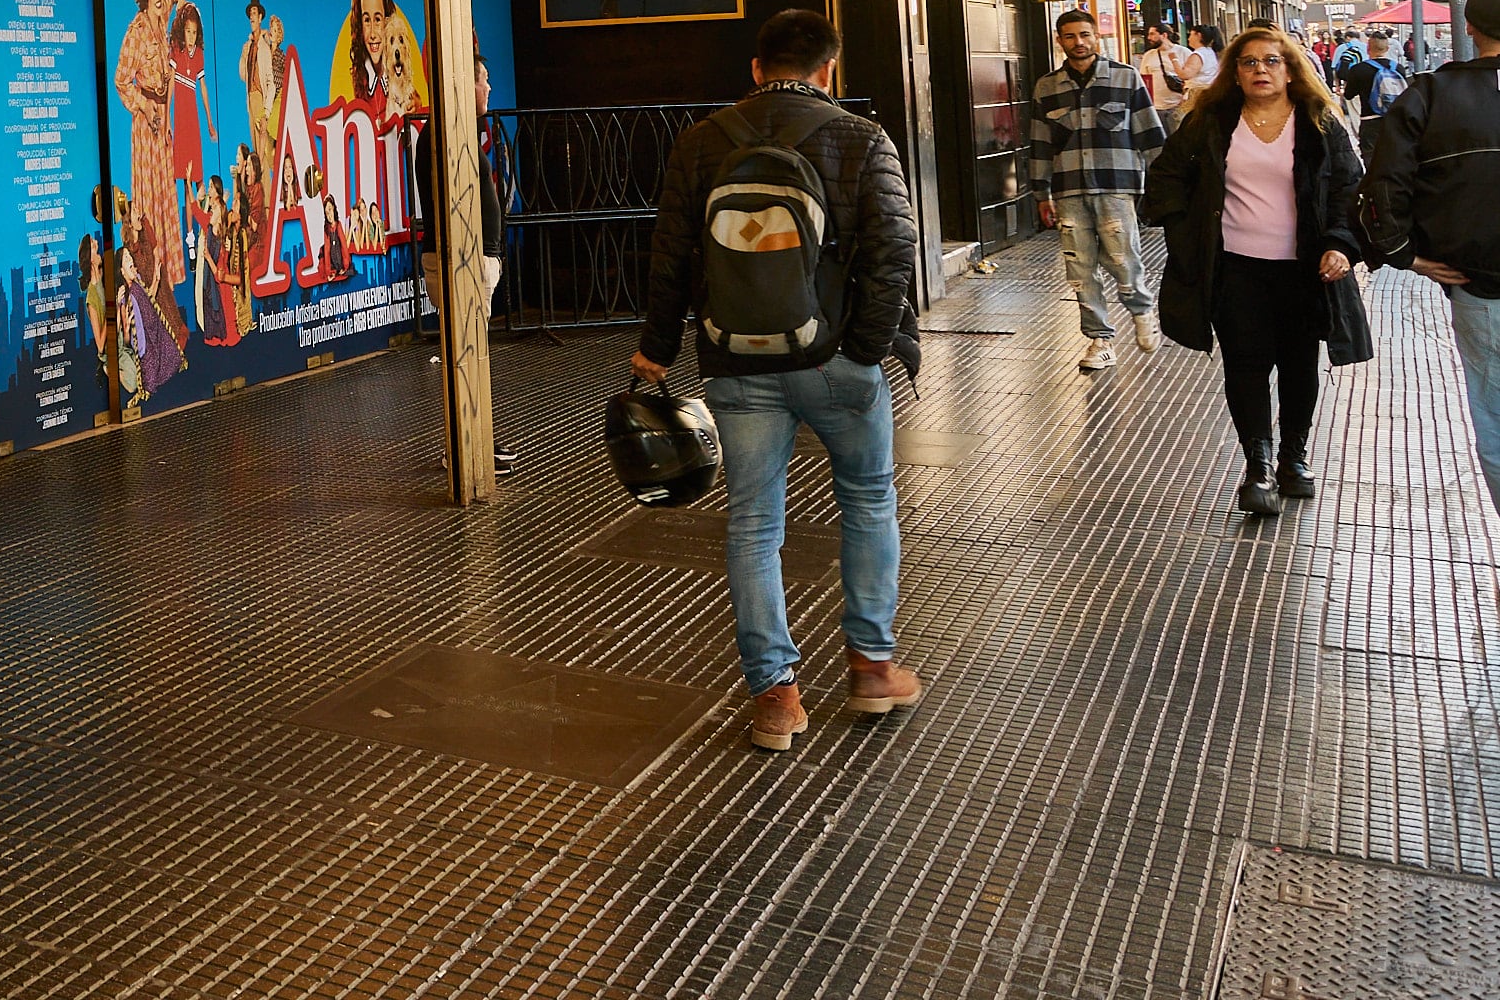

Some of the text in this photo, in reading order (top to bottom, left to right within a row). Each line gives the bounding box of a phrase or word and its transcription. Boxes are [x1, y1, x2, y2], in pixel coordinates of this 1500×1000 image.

[259, 308, 295, 333] Producción
[295, 301, 320, 324] Artística
[320, 294, 349, 319] GUSTAVO
[349, 285, 388, 312] YANKELEVICH
[392, 279, 415, 302] NICOLÁS
[299, 326, 312, 348] Una
[312, 317, 346, 348] producción
[345, 318, 354, 336] de
